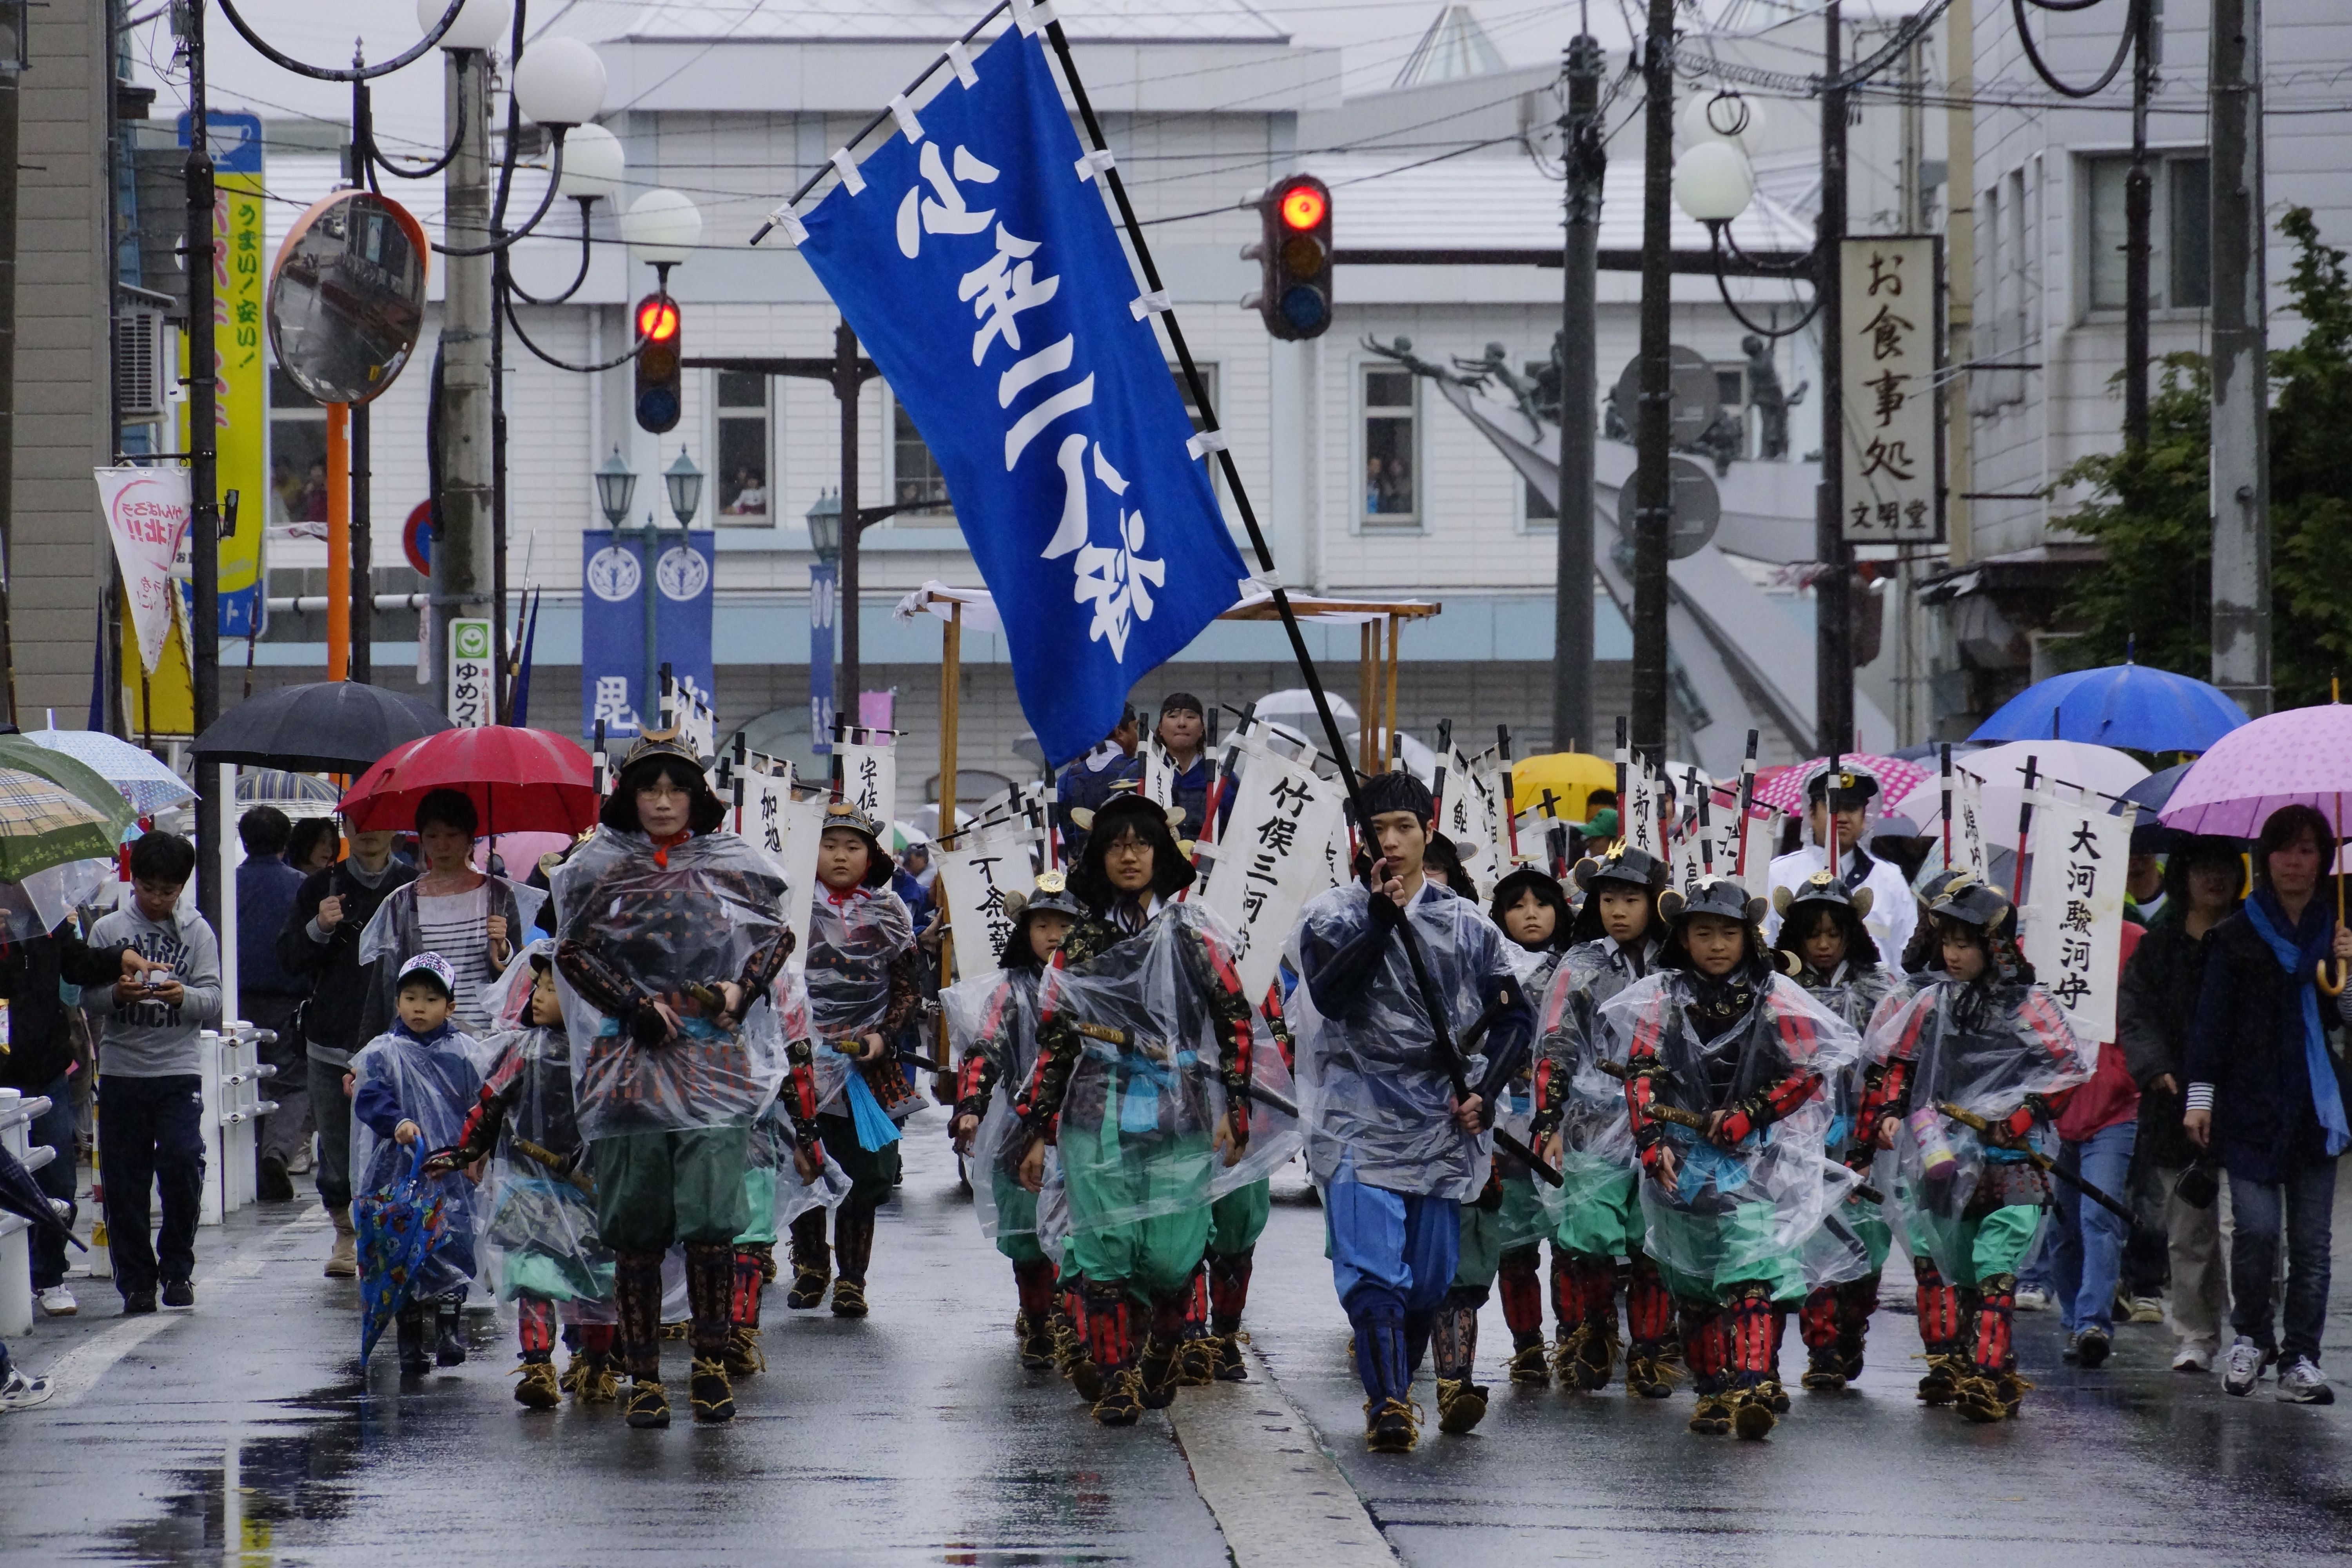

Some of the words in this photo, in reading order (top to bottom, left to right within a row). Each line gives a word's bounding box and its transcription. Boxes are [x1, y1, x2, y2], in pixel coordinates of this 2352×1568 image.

[1859, 250, 1915, 481] お食事処
[1850, 499, 1929, 529] 文明堂
[456, 662, 478, 728] ゆめク
[591, 676, 641, 731] 毘
[760, 788, 782, 852] 加地
[856, 756, 878, 822] 宇佐
[1454, 797, 1467, 844] 鮎
[1236, 777, 1314, 961] 竹俣三河守
[2053, 820, 2101, 1009] 大河駿河守
